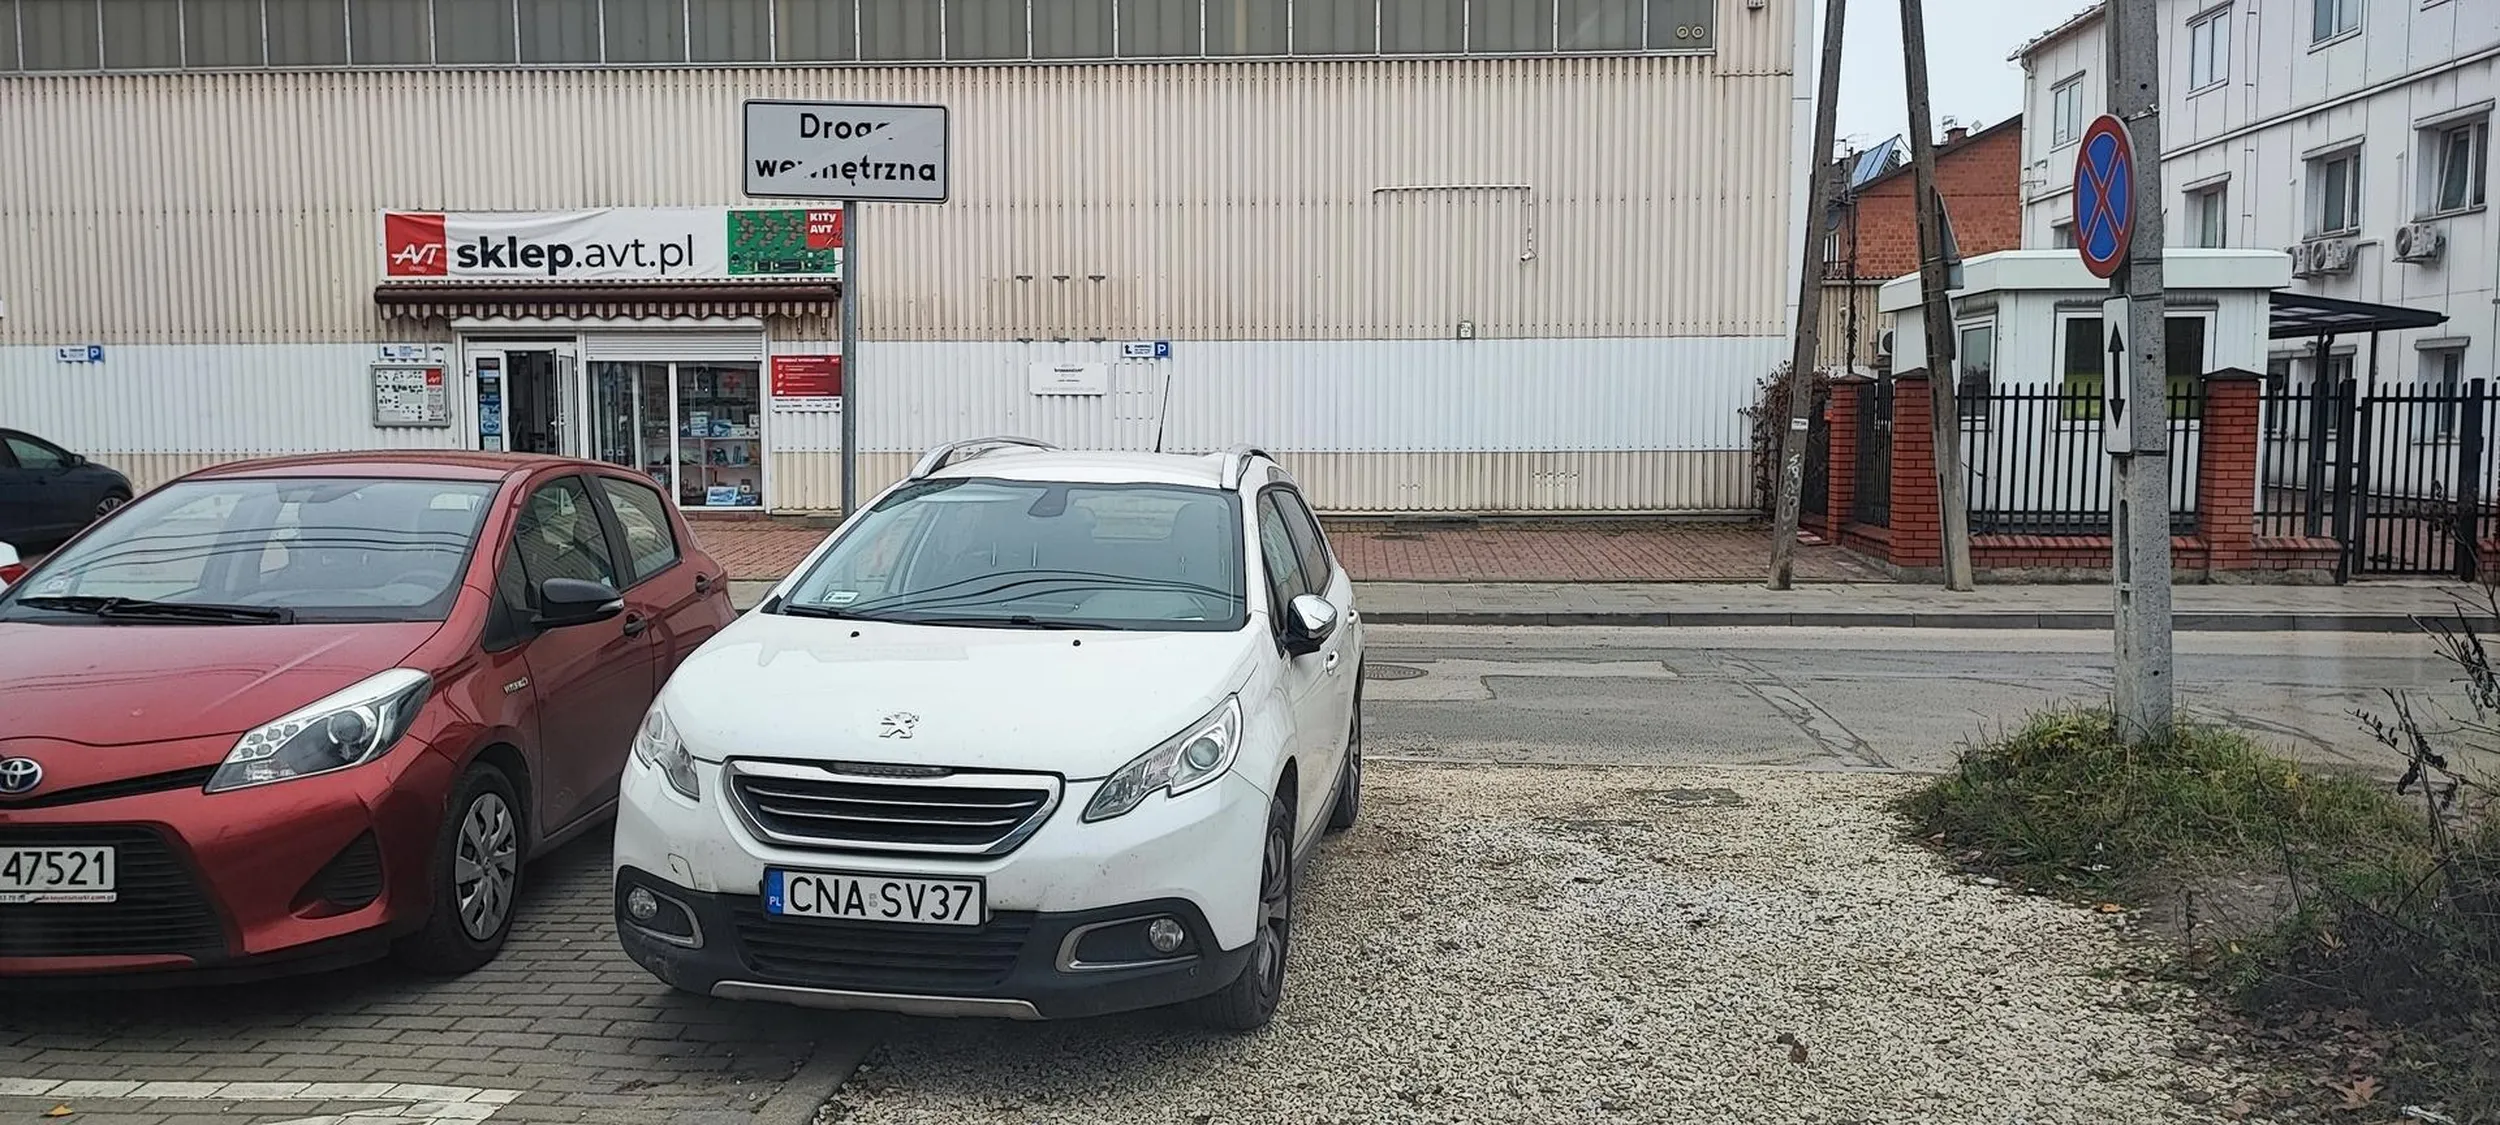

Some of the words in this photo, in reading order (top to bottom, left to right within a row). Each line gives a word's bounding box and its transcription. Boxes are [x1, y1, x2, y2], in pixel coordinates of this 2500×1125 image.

[800, 112, 893, 141] Dro
[810, 224, 833, 234] AVT
[391, 243, 442, 265] AVT
[456, 234, 694, 276] sklep.avt.pl
[2, 850, 105, 885] 47521
[769, 895, 782, 907] PL
[789, 876, 867, 917] CNA
[880, 882, 973, 921] SV37
